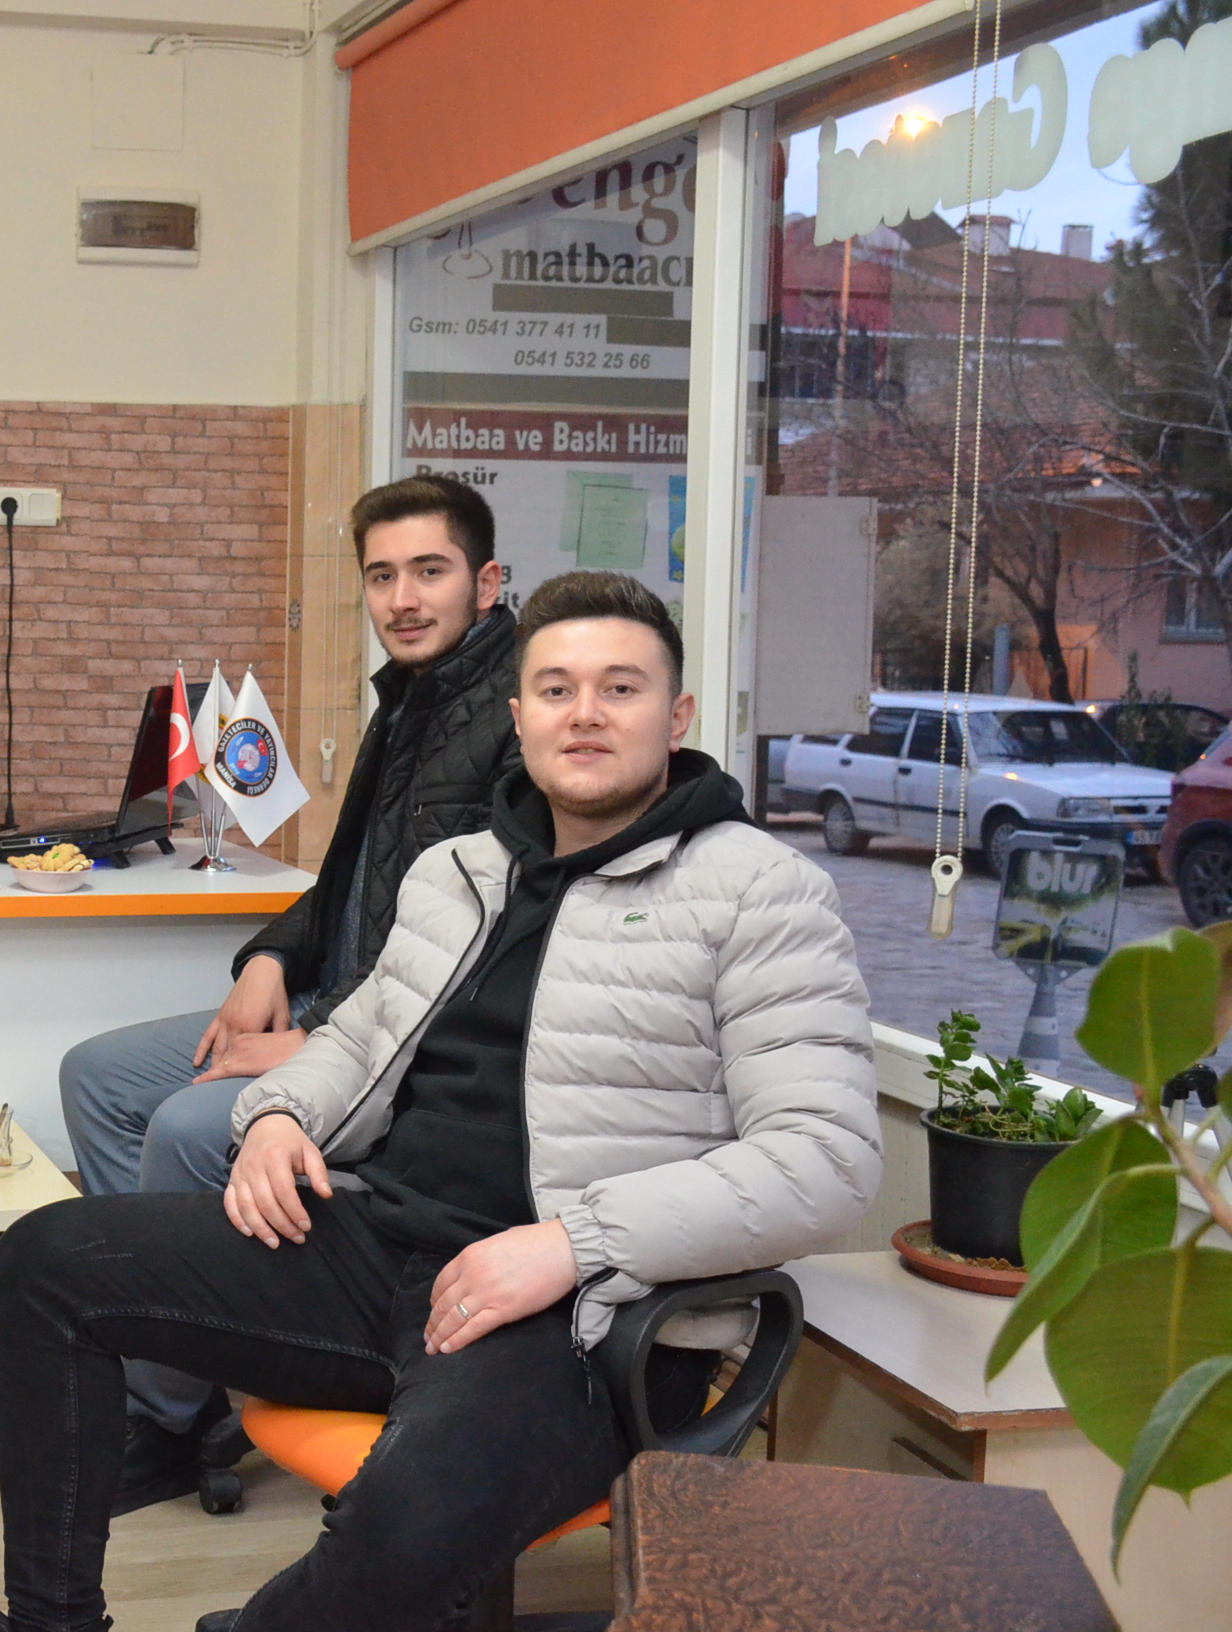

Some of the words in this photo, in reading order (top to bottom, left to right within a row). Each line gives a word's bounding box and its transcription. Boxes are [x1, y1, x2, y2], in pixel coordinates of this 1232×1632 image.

[409, 316, 459, 335] Gsm:
[465, 318, 509, 336] 0541
[515, 320, 549, 338] 377
[554, 321, 575, 339] 41
[582, 322, 601, 340] 11
[514, 350, 556, 367] 0541
[564, 352, 597, 368] 532
[602, 353, 624, 369] 25
[629, 353, 651, 370] 66
[406, 417, 505, 451] Matbaa
[514, 429, 543, 451] ve
[553, 420, 617, 453] Baskı
[257, 725, 266, 736] VE
[216, 762, 237, 788] MANİSA
